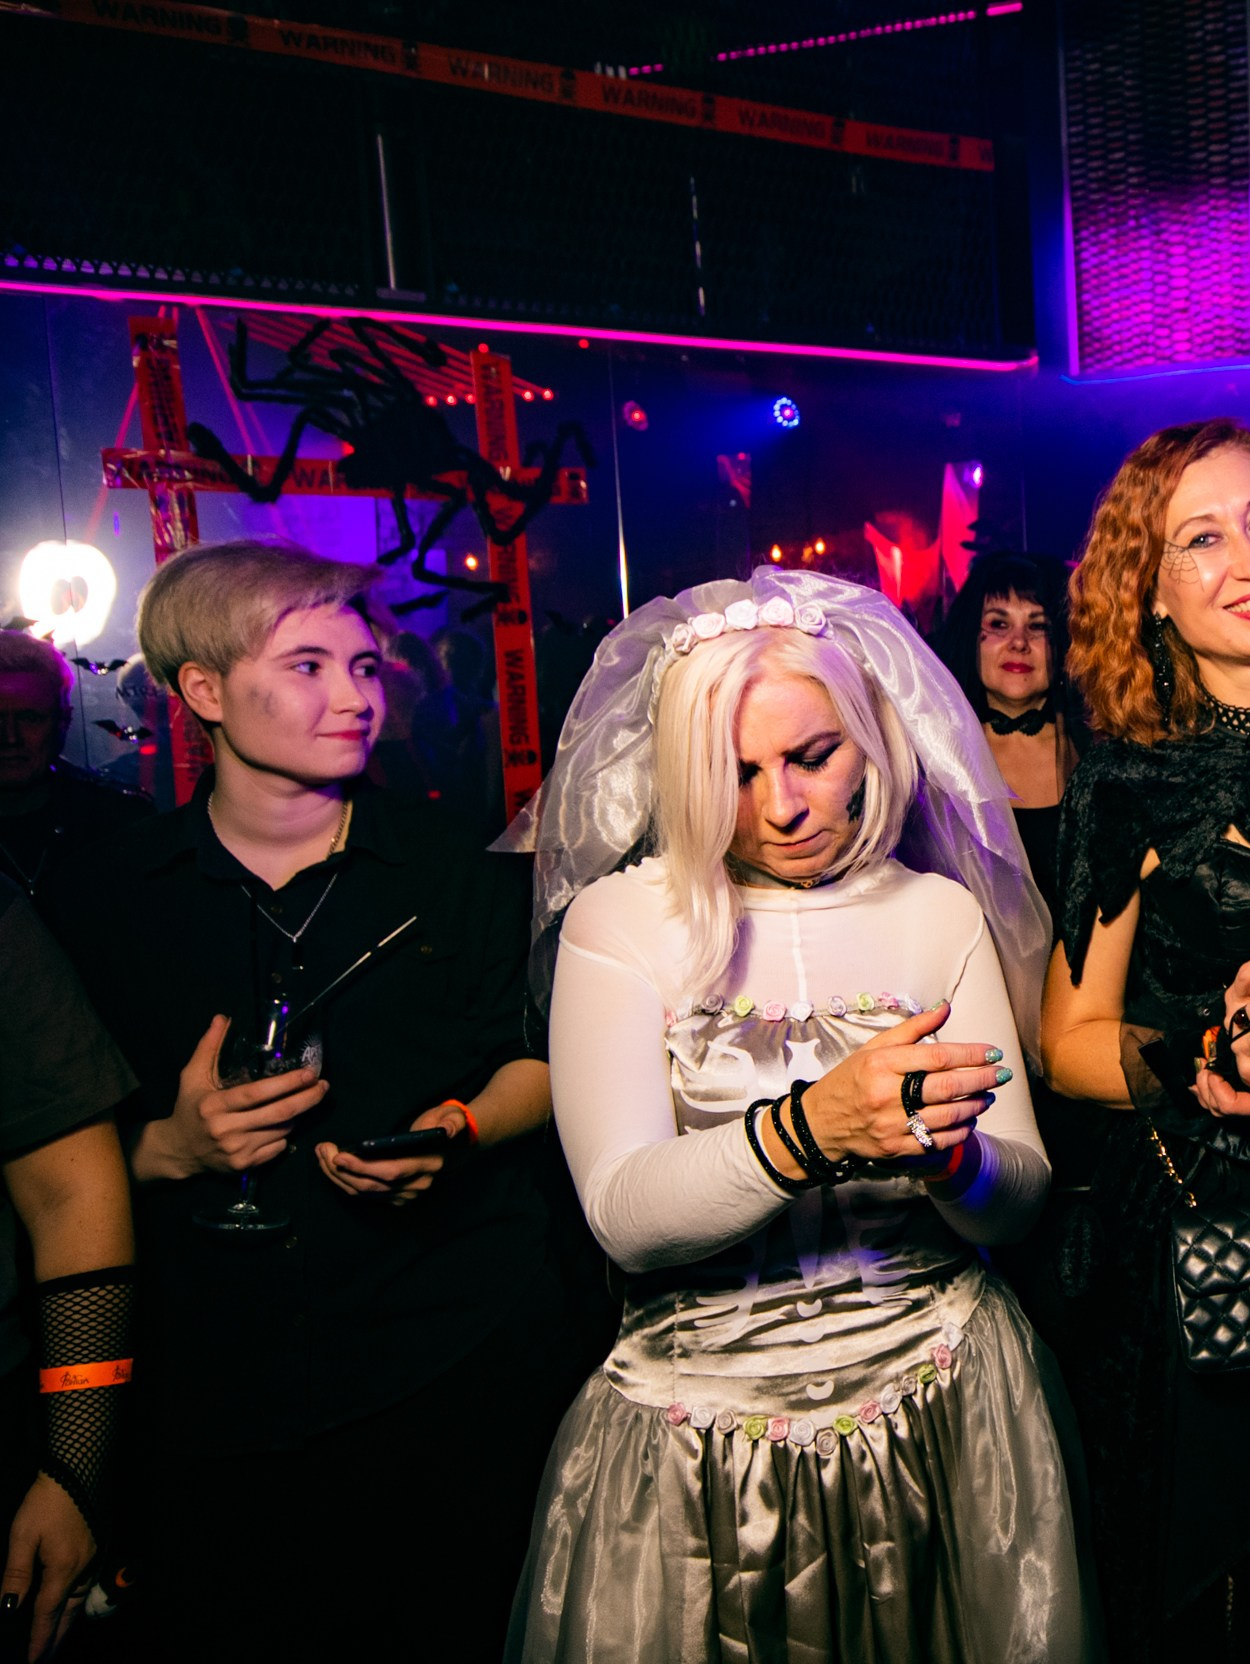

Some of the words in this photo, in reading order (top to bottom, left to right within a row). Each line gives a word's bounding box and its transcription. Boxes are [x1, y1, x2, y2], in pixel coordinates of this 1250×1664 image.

[278, 28, 396, 64] WARNING
[450, 56, 554, 93] WARNING
[603, 83, 697, 118] WARNING
[738, 108, 827, 139] WARNING
[480, 361, 509, 467] WARNING
[505, 649, 530, 745] WARNING
